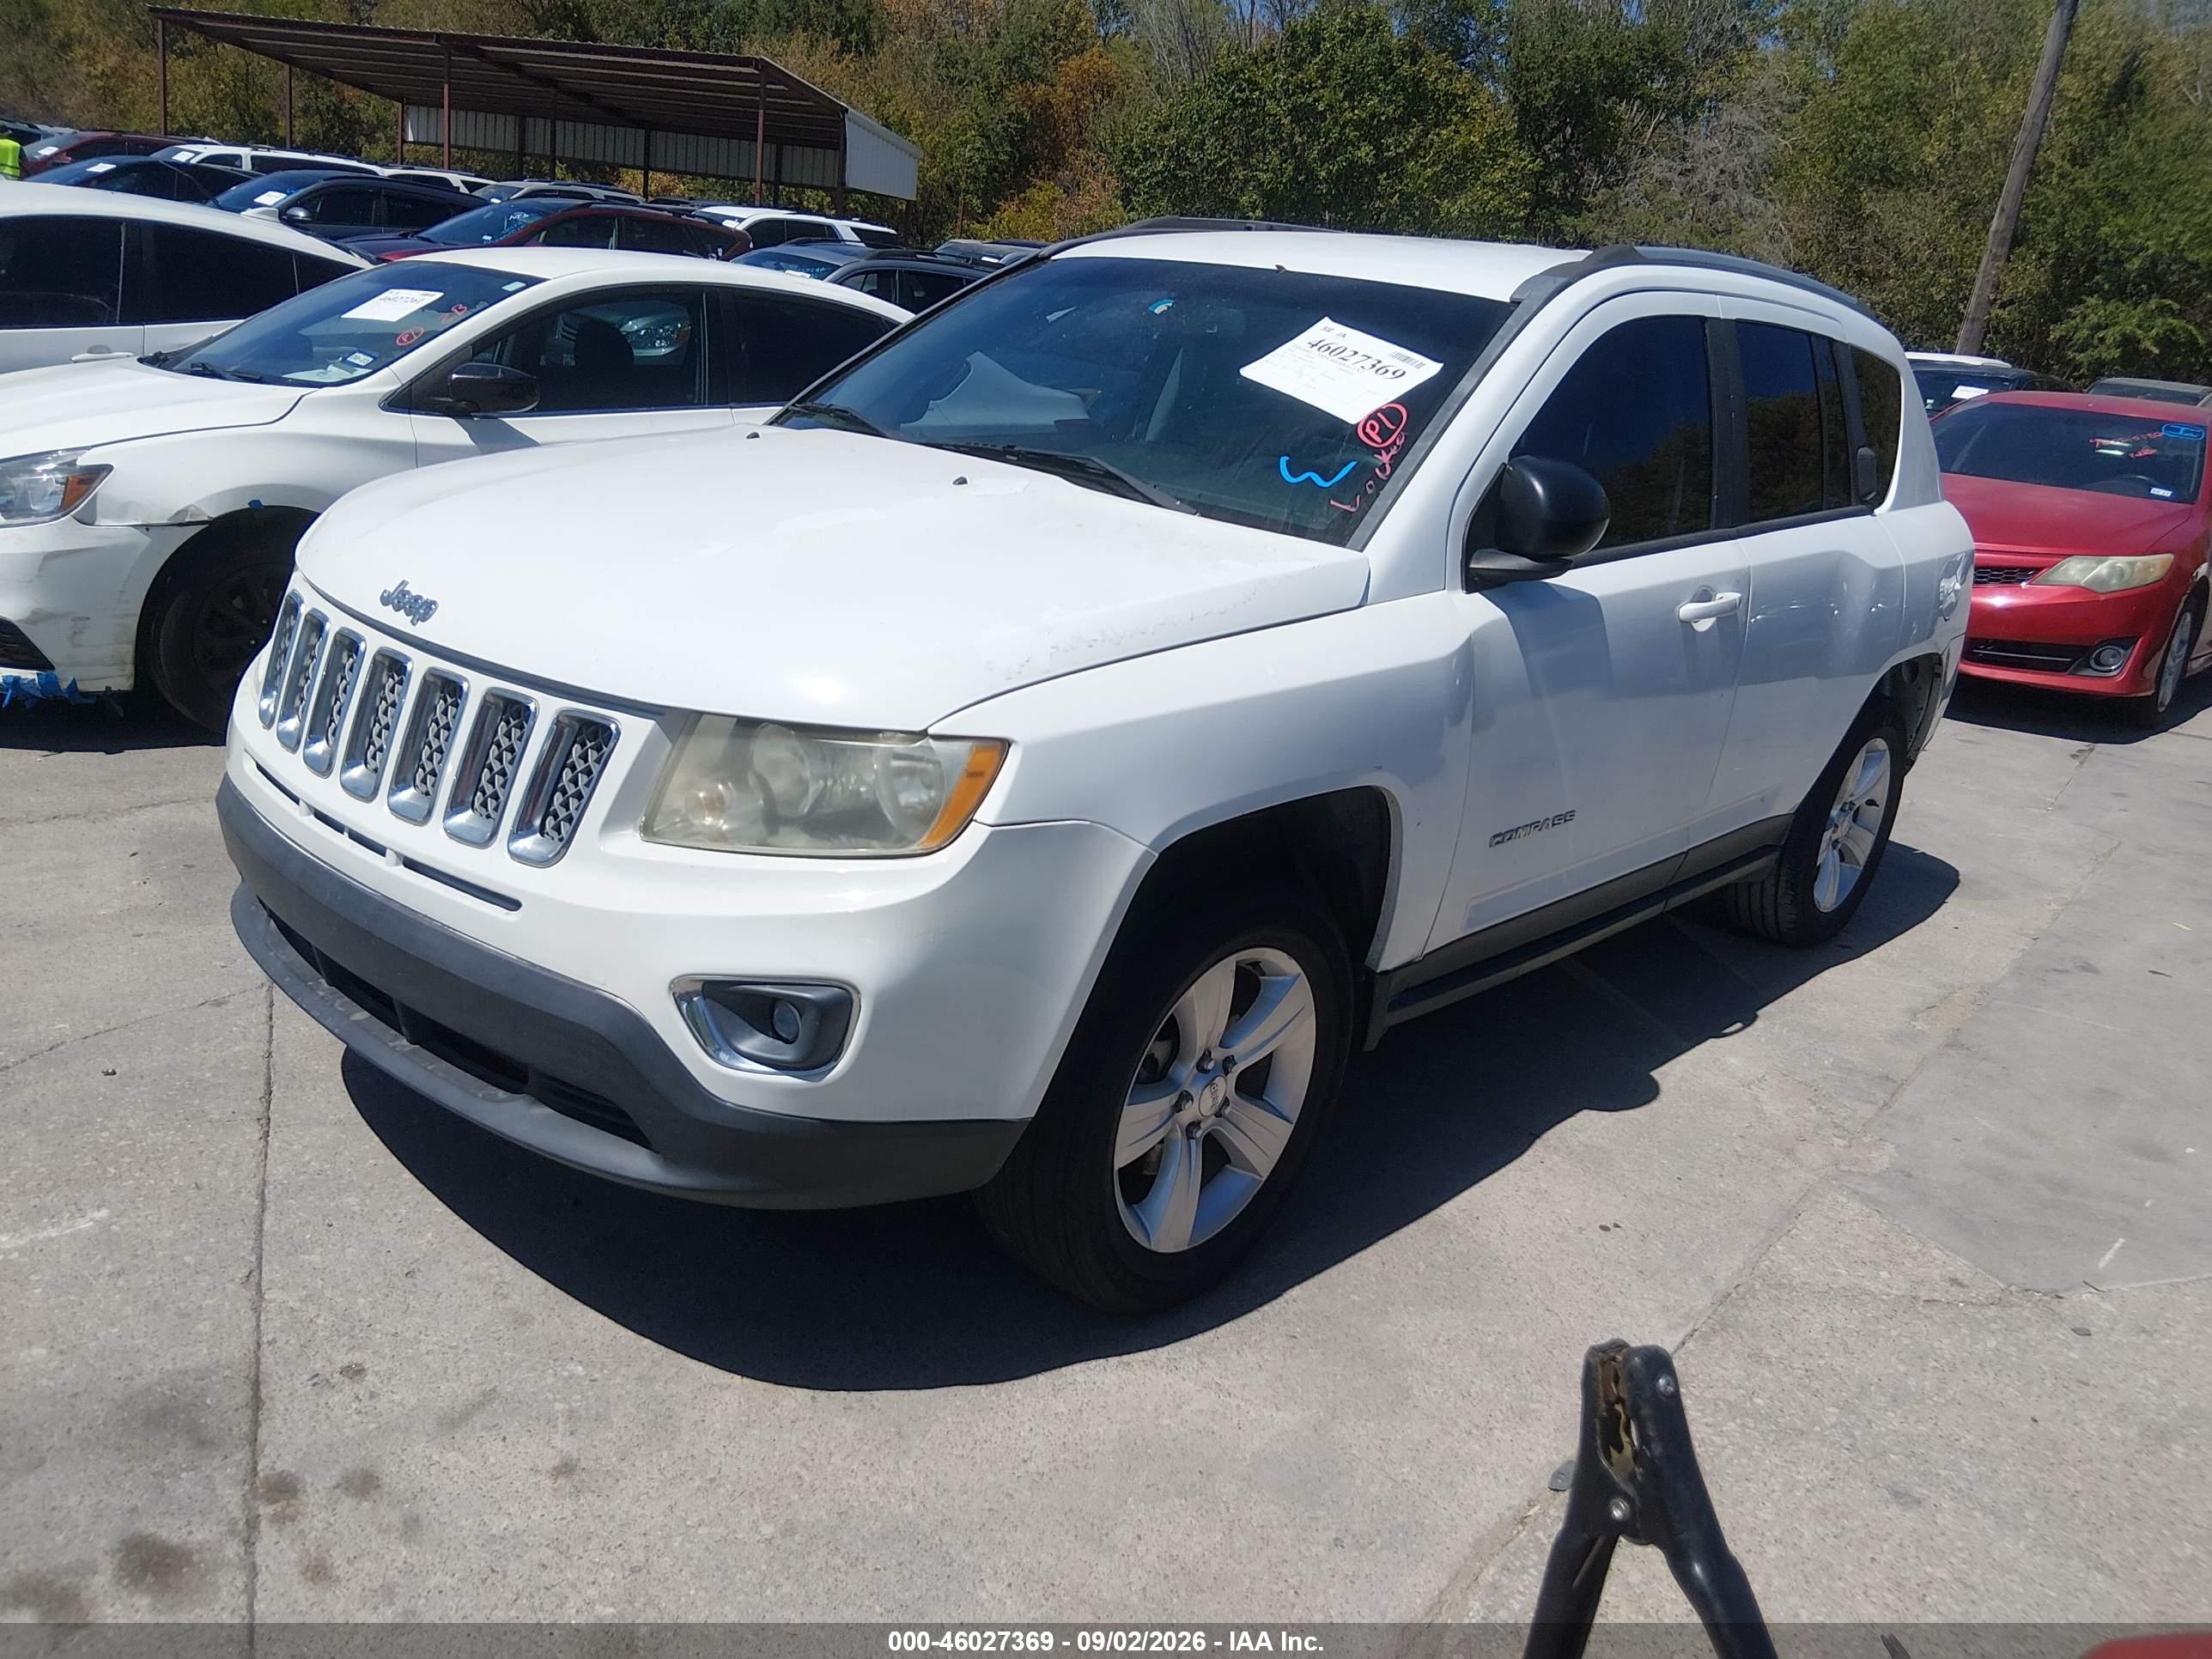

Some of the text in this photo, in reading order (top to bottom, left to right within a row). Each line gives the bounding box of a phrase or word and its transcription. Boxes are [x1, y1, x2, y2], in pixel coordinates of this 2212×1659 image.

[1308, 338, 1407, 380] 46027369
[380, 580, 439, 626] Jeep
[1489, 810, 1577, 848] COMPASS
